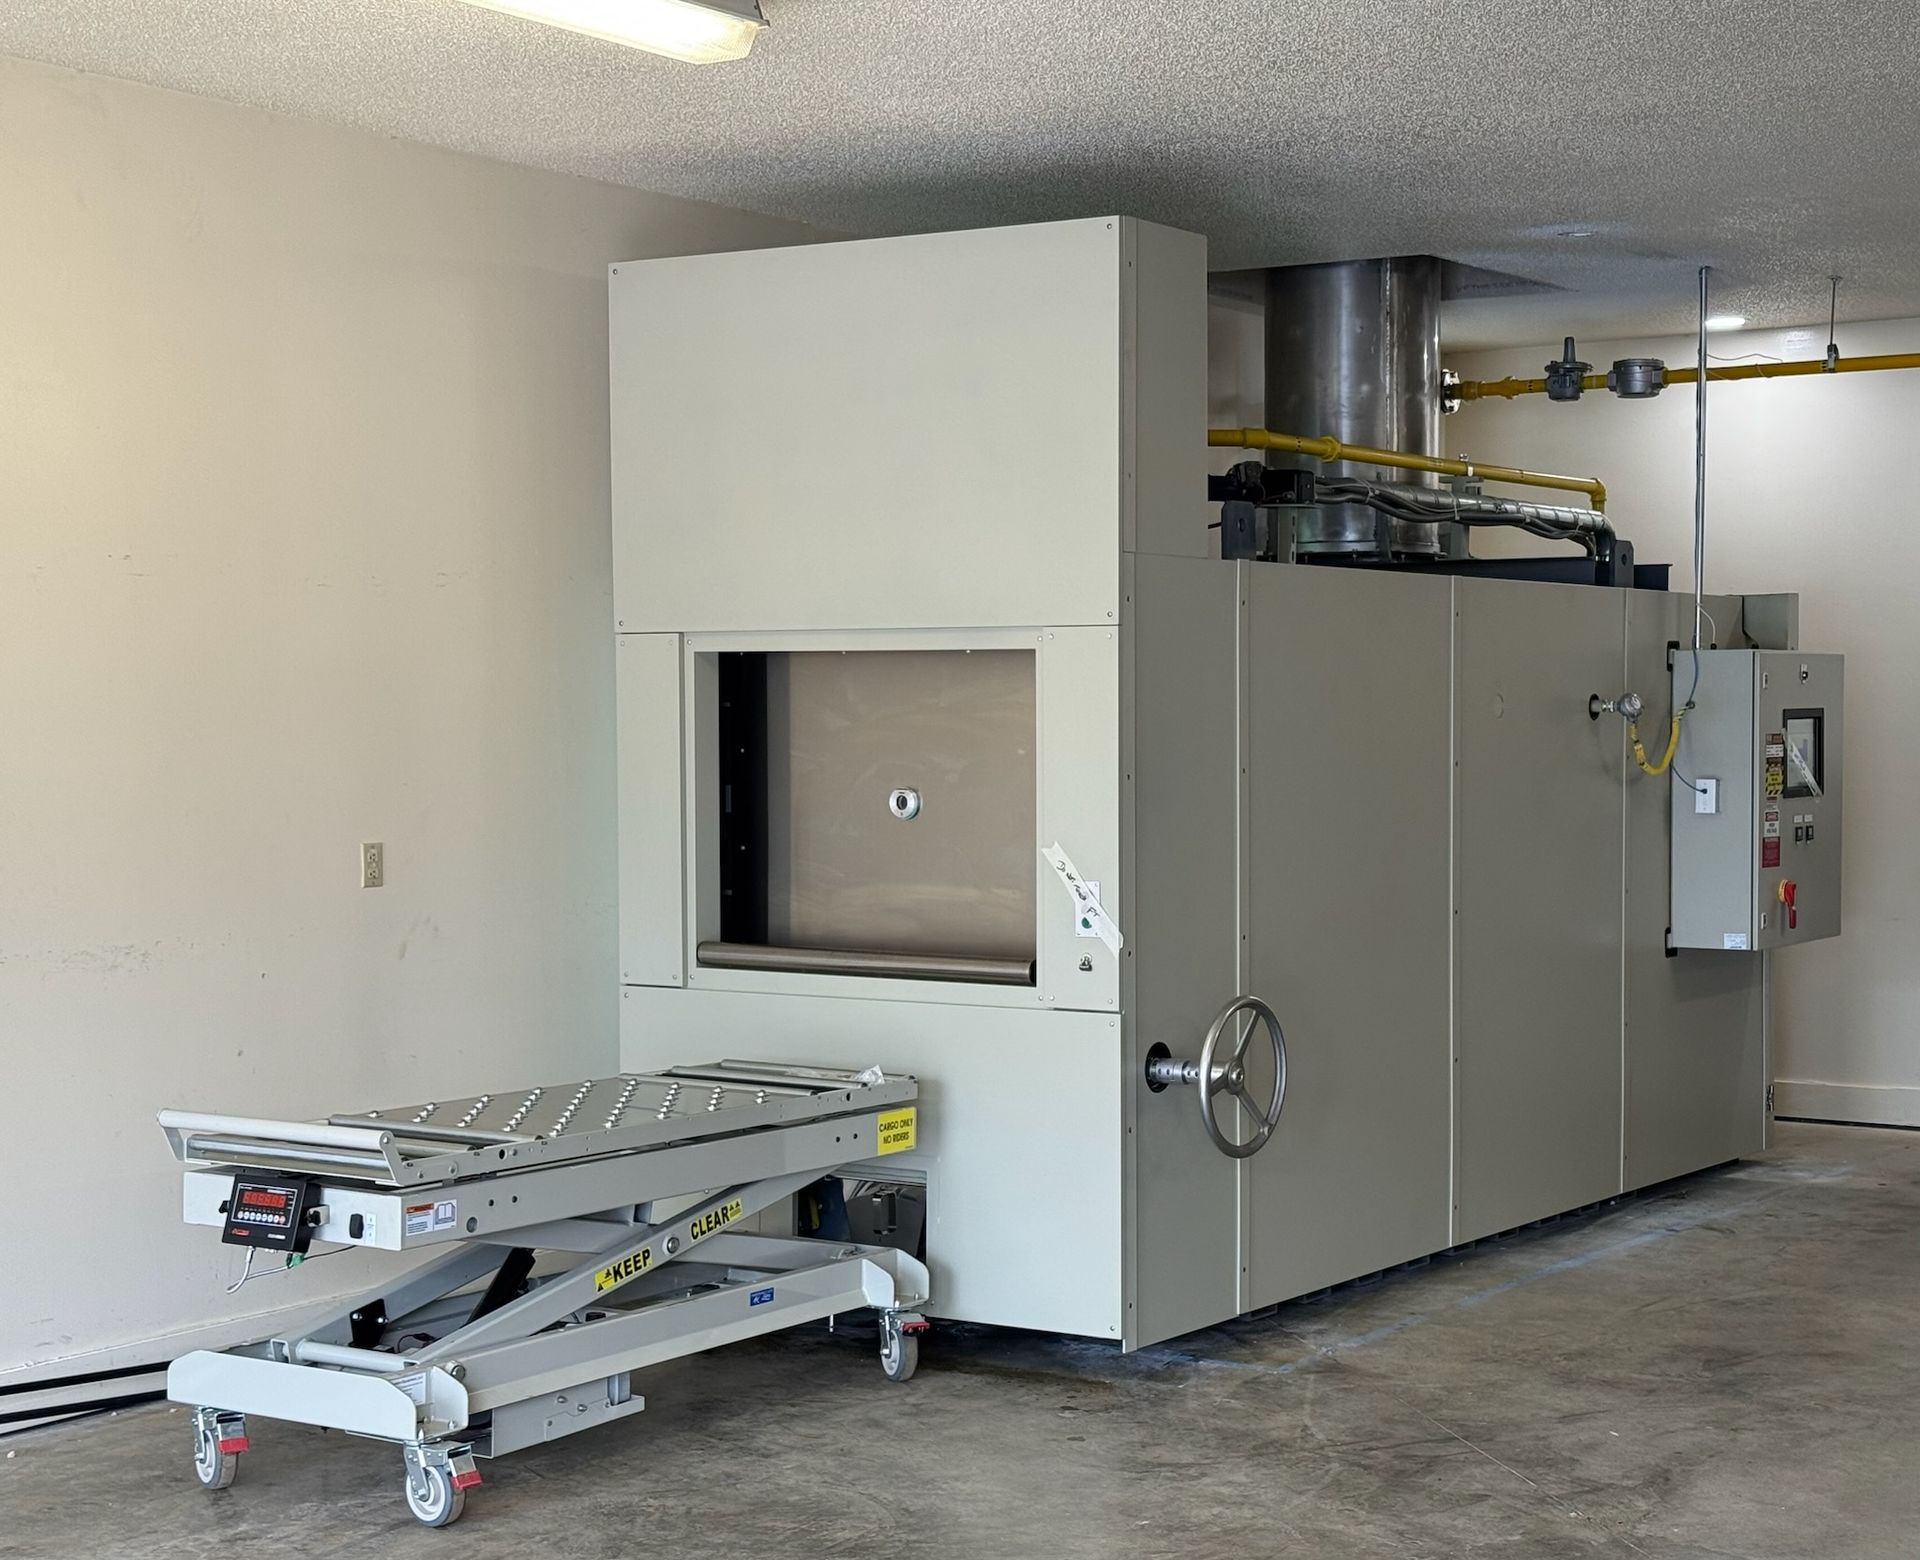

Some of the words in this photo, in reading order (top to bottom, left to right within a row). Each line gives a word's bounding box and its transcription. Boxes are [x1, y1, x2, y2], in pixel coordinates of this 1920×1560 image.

[879, 1120, 899, 1132] CARGO
[900, 1118, 914, 1129] ONLY
[883, 1135, 892, 1144] NO
[893, 1132, 910, 1143] RIDERS
[612, 1249, 651, 1283] KEEP
[690, 1208, 731, 1241] CLEAR
